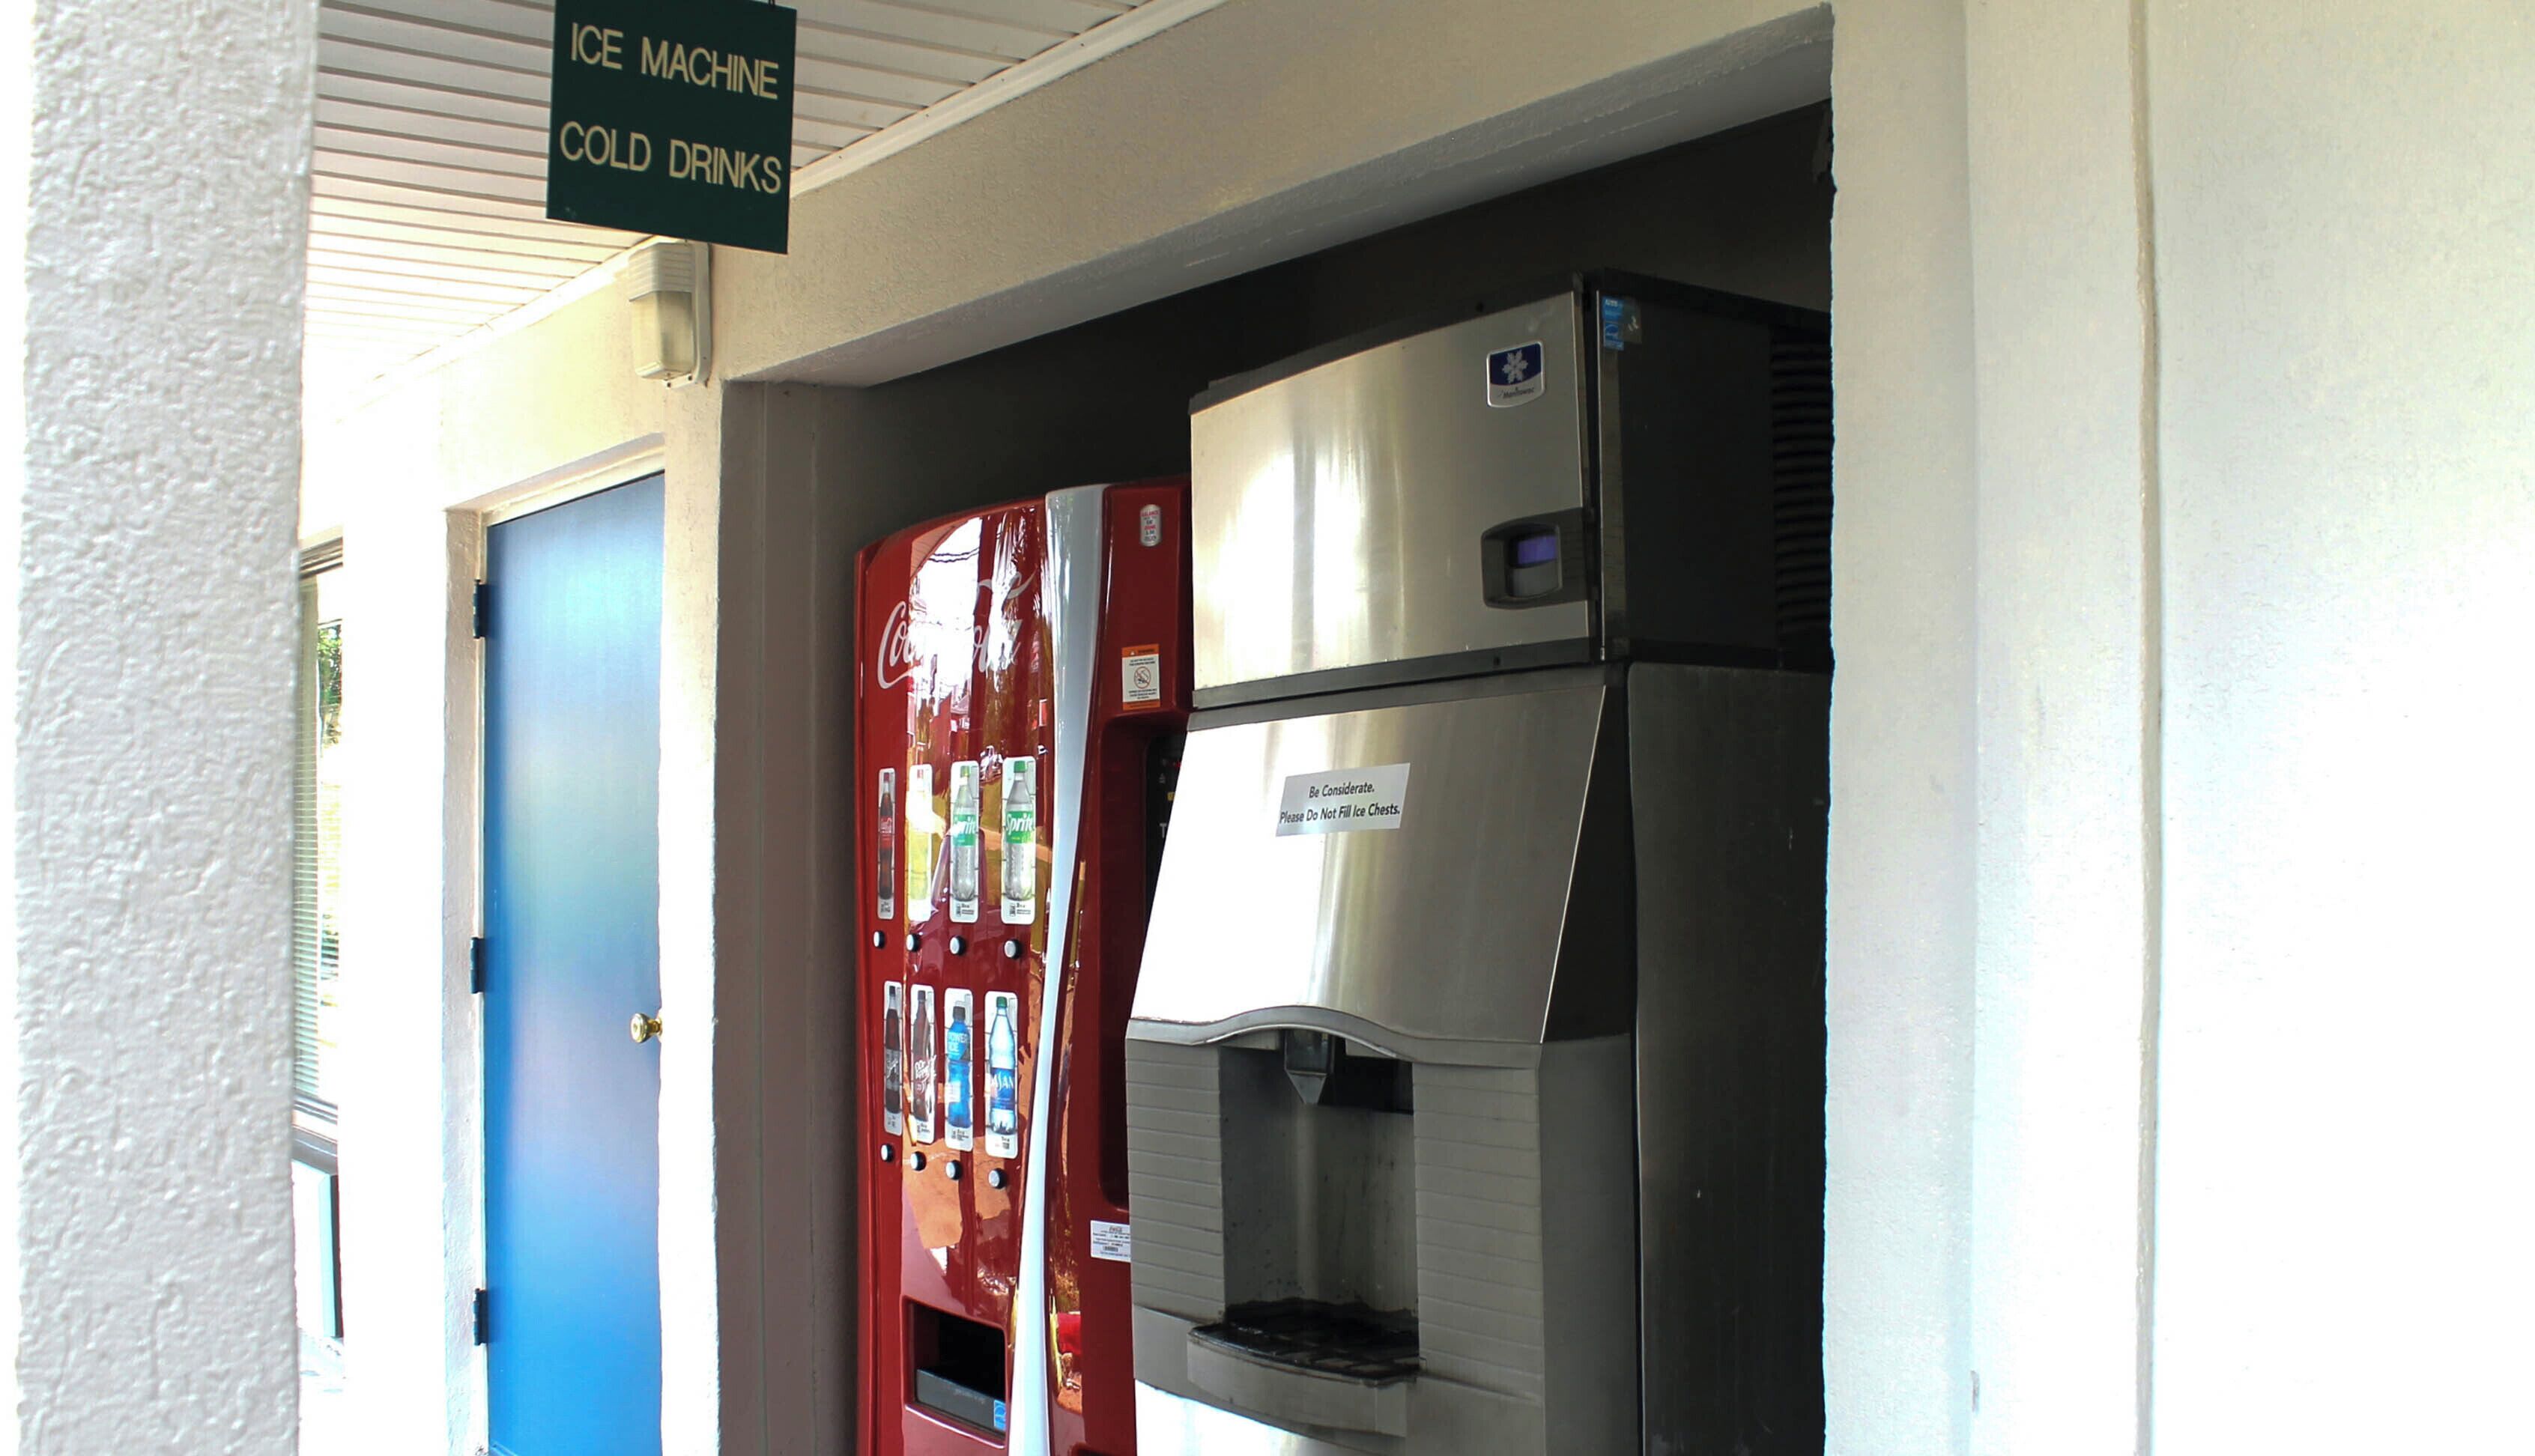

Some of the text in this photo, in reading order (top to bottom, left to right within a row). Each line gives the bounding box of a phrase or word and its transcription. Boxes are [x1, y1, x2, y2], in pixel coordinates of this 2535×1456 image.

[571, 22, 779, 100] ICE MACHINE
[560, 121, 782, 194] COLD DRINKS
[1309, 781, 1375, 798] Be Considerate.
[1279, 803, 1400, 824] Please Do Not Fill Ice Chests.
[953, 815, 978, 837] rite
